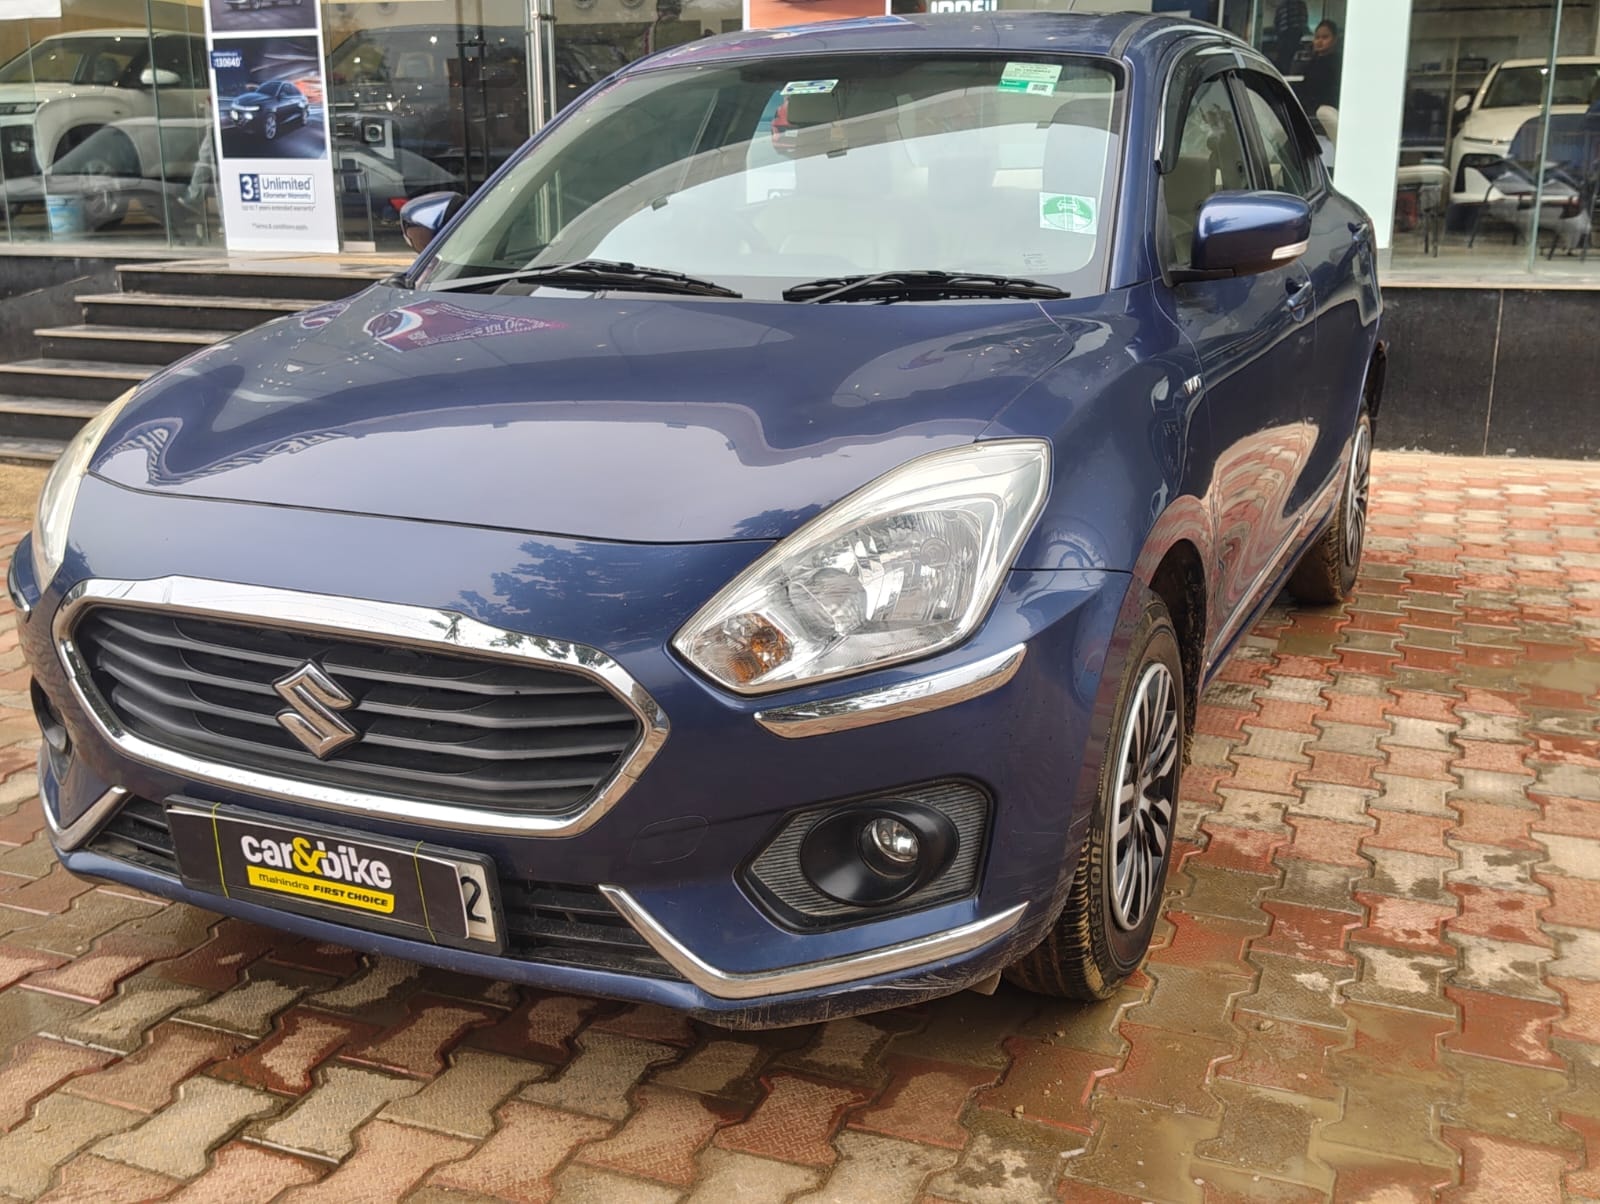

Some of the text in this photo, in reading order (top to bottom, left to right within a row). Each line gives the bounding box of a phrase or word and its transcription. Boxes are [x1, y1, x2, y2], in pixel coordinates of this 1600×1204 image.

[241, 175, 254, 200] 3
[240, 835, 393, 890] car&bike
[313, 884, 345, 898] FIRST
[347, 886, 389, 907] CHOICE
